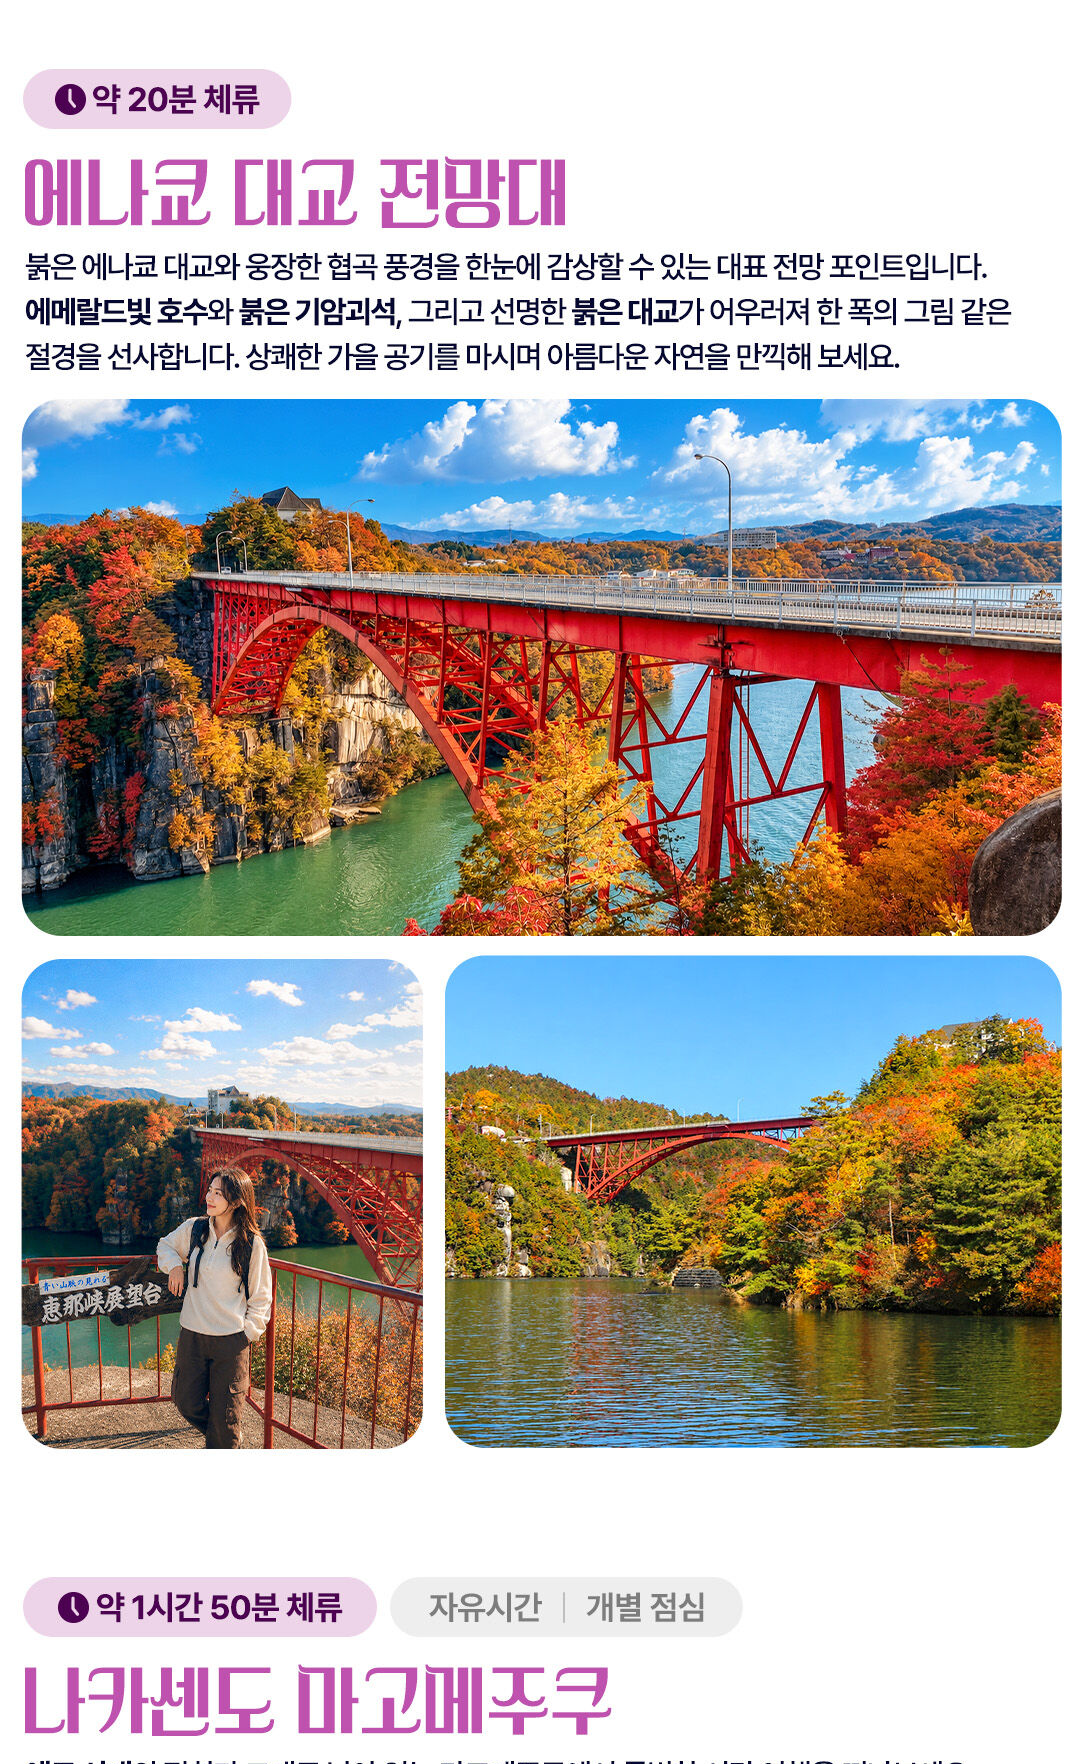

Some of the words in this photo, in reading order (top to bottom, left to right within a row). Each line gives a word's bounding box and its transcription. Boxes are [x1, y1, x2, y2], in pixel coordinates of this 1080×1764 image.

[41, 1282, 162, 1324] 恵那峡展望台
